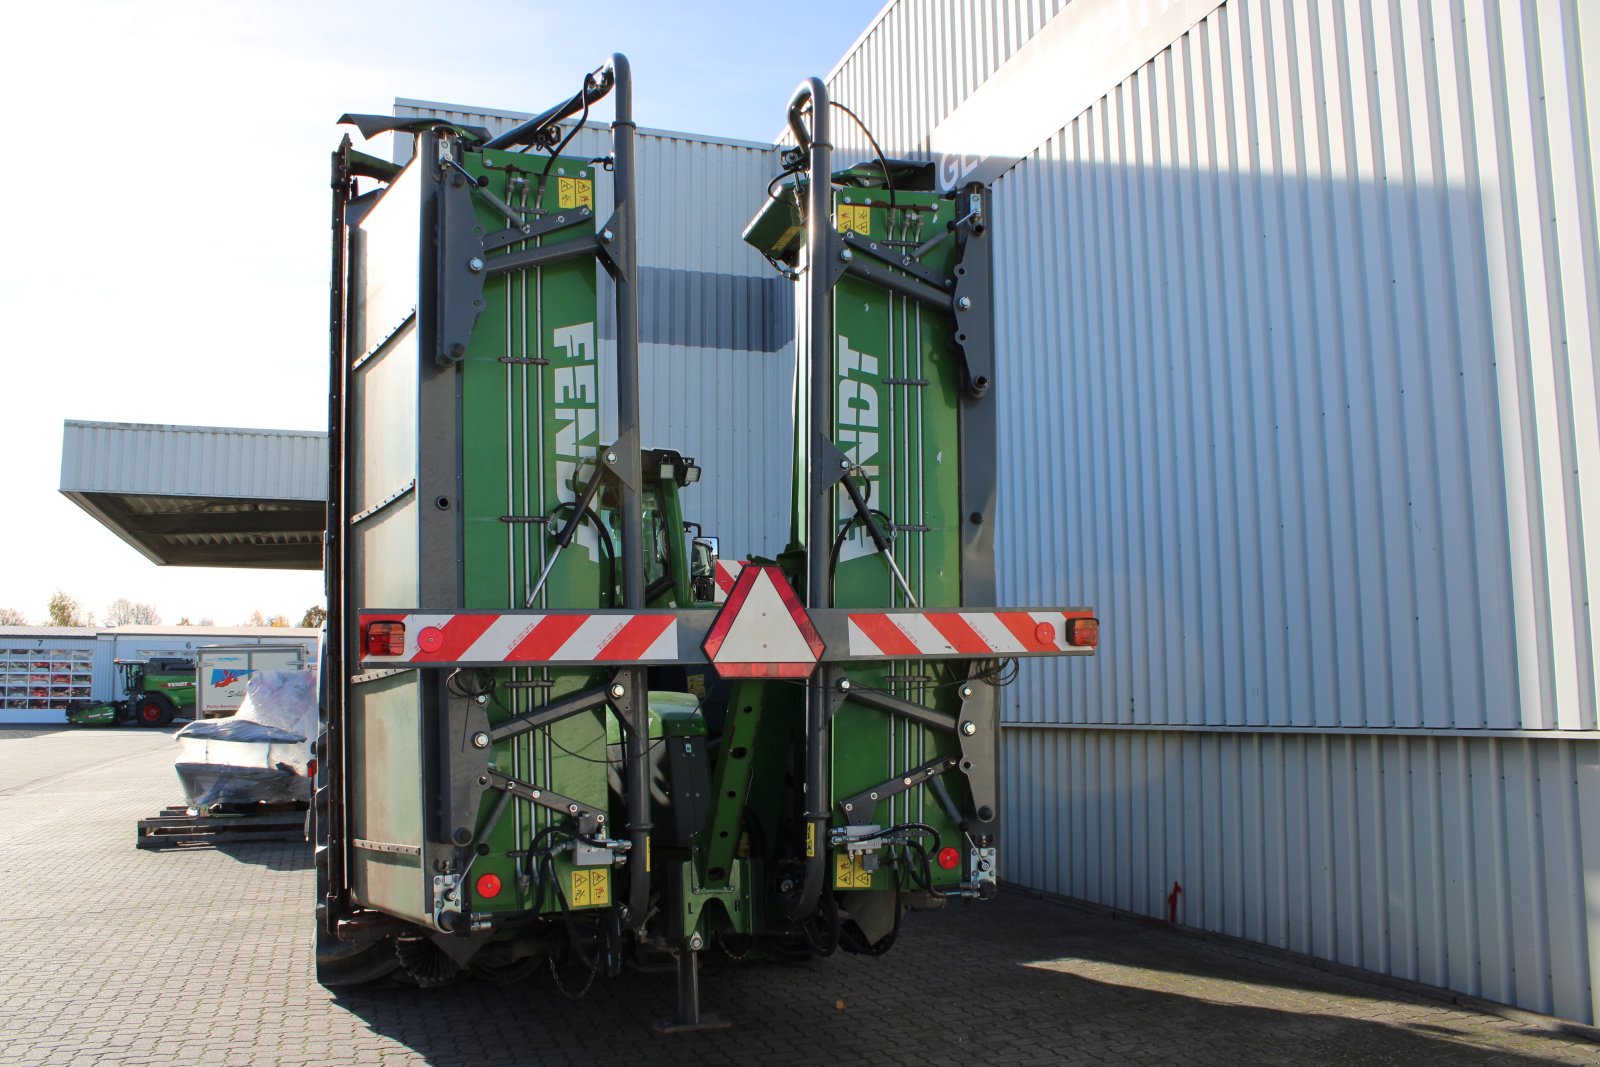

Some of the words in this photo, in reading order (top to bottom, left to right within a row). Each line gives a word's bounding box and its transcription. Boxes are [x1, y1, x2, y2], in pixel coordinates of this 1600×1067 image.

[553, 321, 600, 564] FENDT
[838, 334, 880, 563] FENDT
[186, 642, 192, 650] 6
